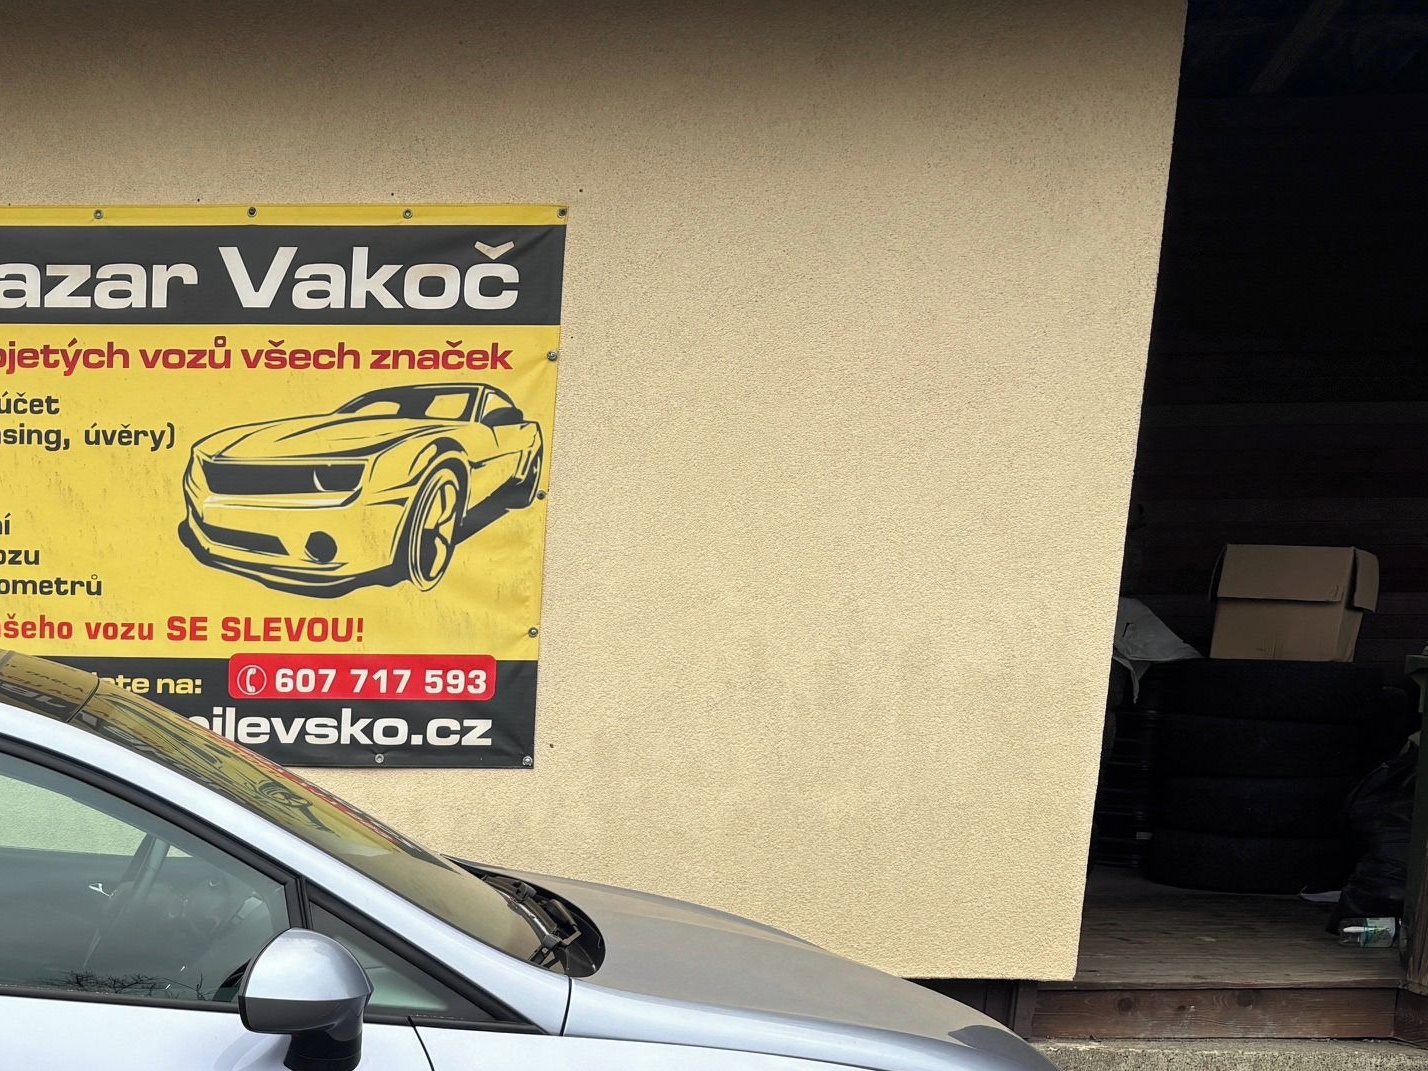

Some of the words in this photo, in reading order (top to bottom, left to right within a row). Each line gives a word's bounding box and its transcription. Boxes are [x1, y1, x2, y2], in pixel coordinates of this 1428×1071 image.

[218, 241, 520, 310] Vakoč
[139, 336, 231, 369] vozů
[241, 339, 360, 370] všech
[370, 340, 513, 370] značek
[84, 422, 175, 452] úvěry)
[85, 621, 154, 641] vozu
[166, 616, 208, 641] SE
[221, 616, 364, 642] SLEVOU!
[156, 677, 202, 694] na:
[275, 668, 337, 694] 607
[350, 669, 411, 694] 717
[424, 669, 487, 694] 593
[188, 706, 493, 746] ilevsko.cz
